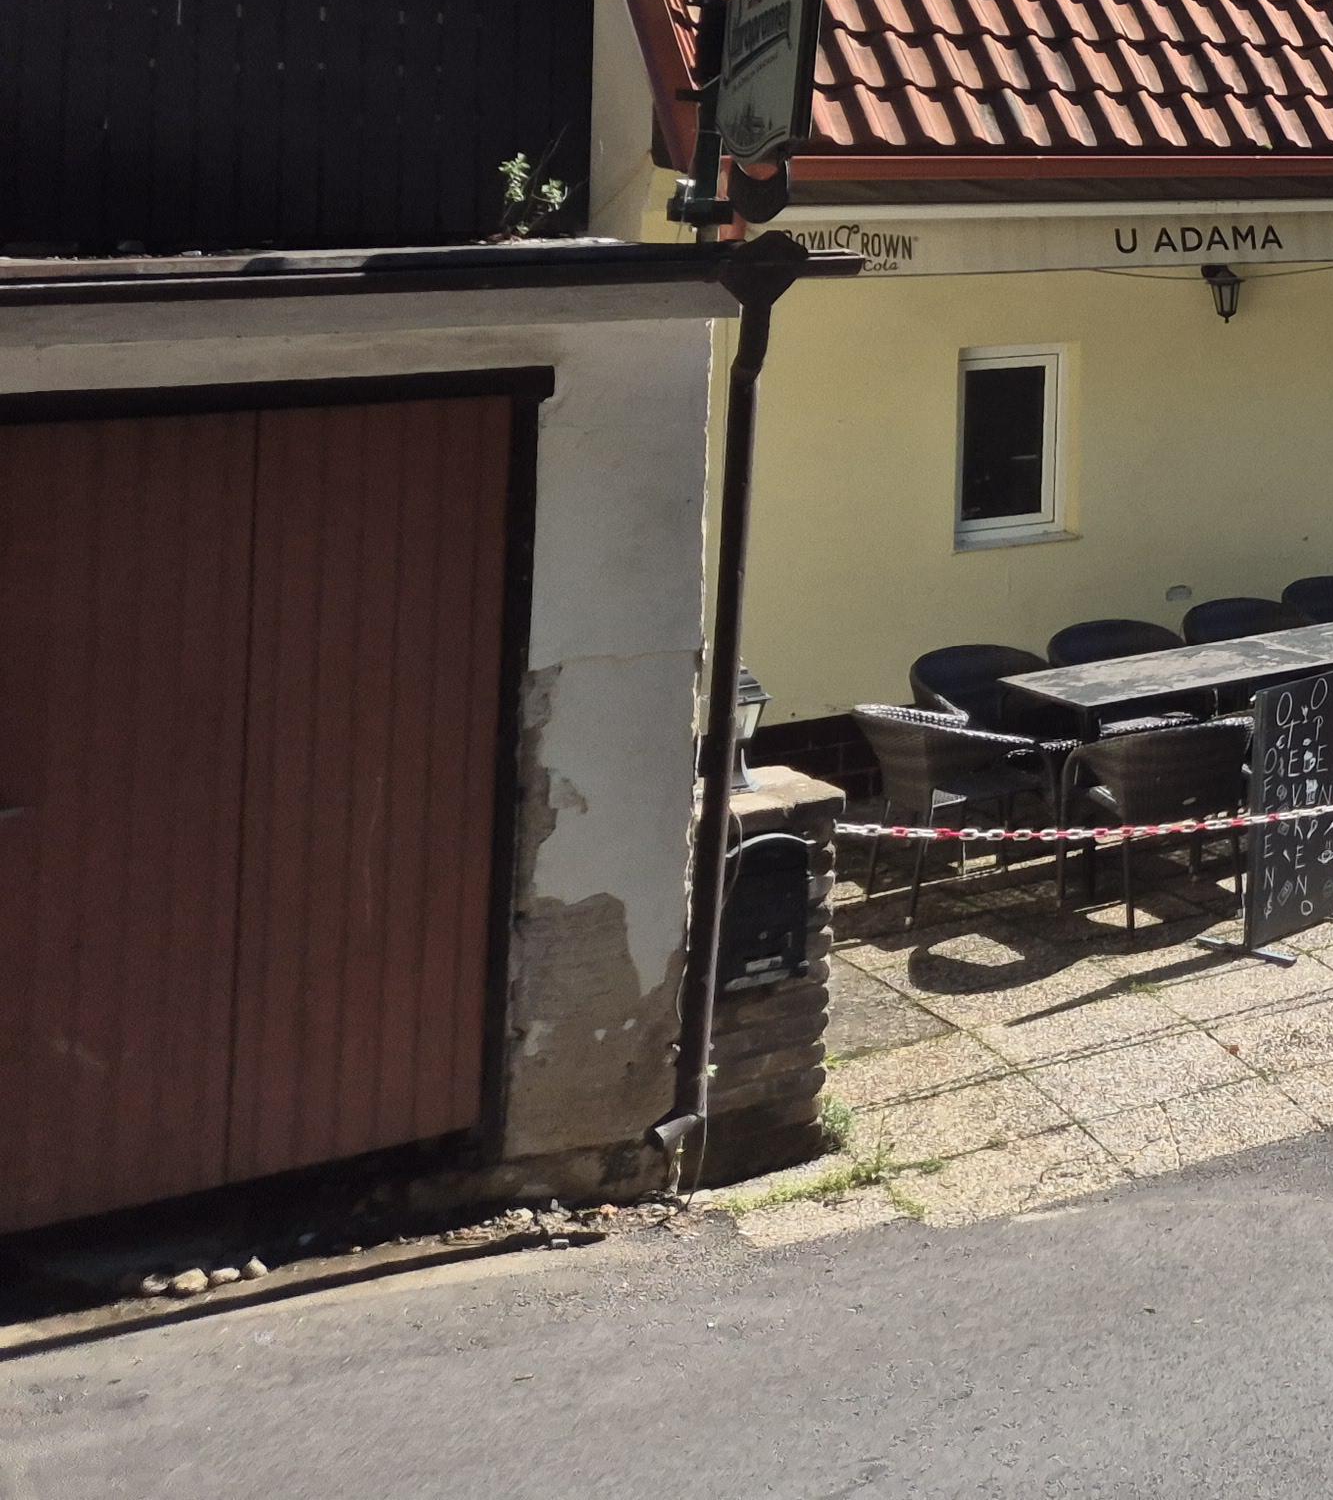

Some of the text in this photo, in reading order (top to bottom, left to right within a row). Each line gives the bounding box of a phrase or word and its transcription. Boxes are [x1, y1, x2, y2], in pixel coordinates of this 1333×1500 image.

[1115, 224, 1283, 254] U ADAMA
[862, 260, 899, 272] Cola
